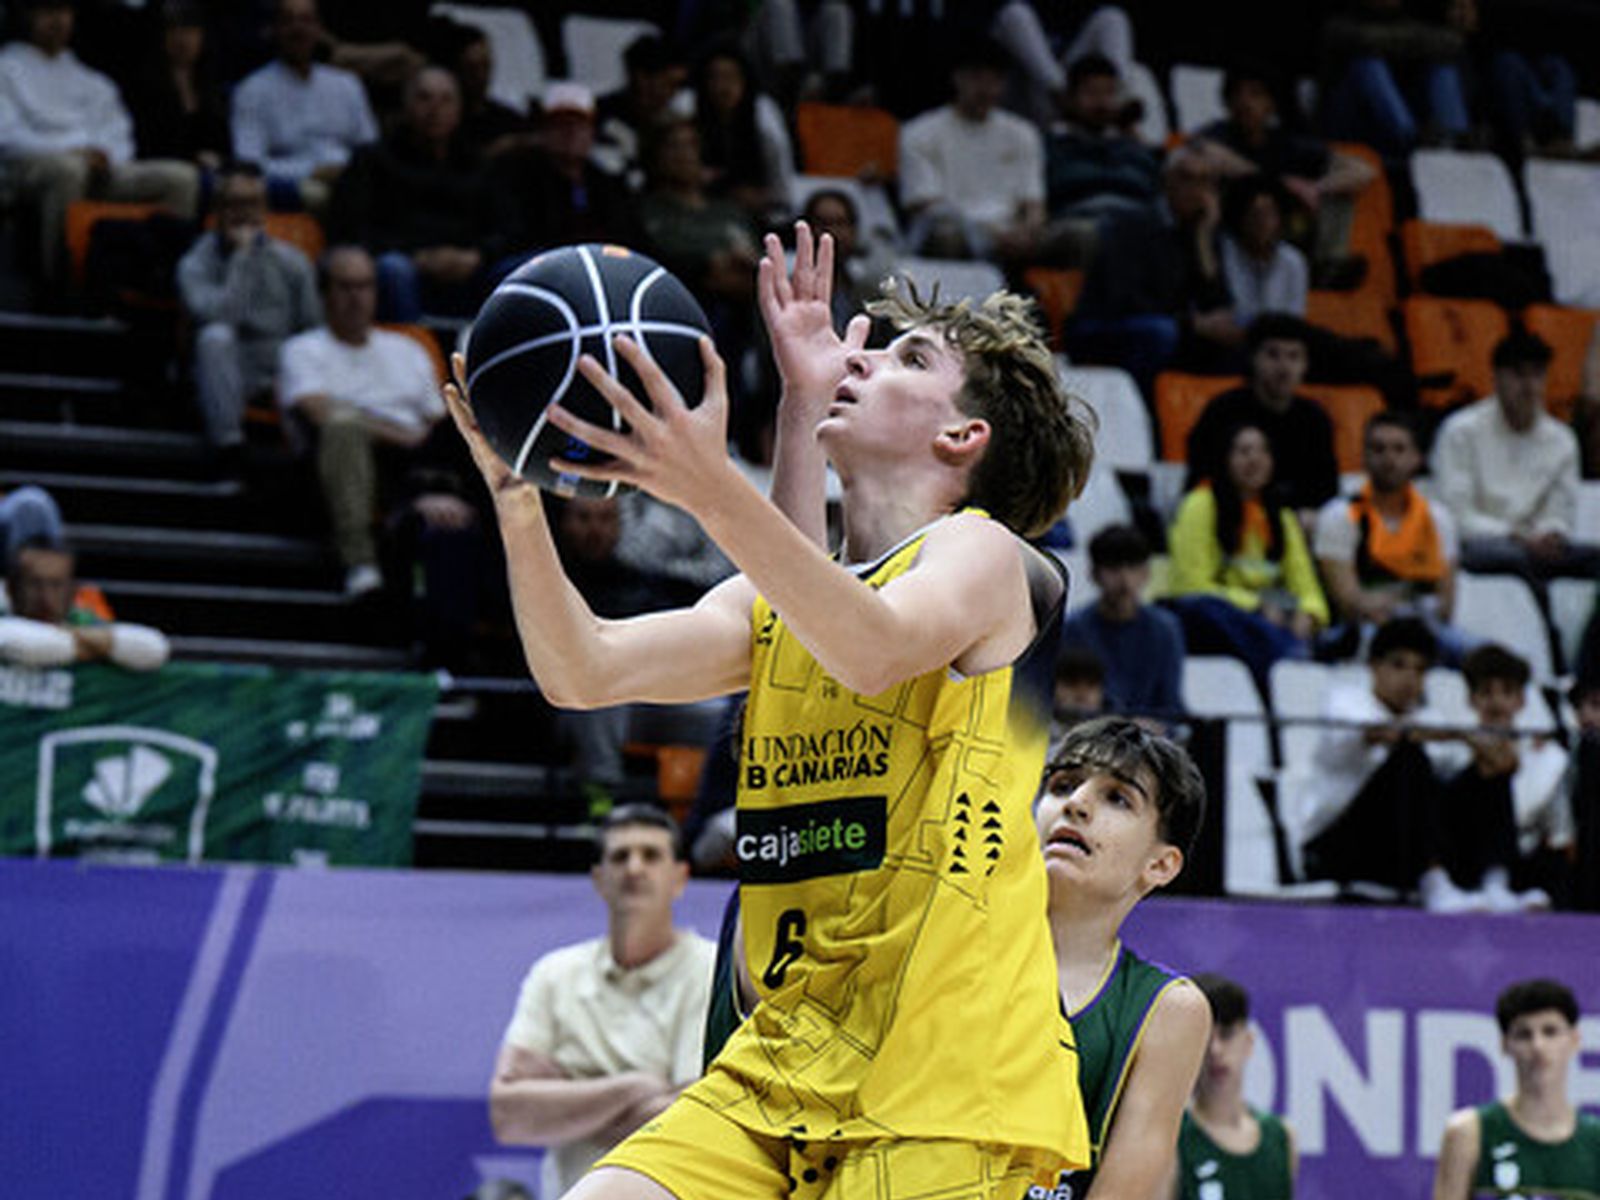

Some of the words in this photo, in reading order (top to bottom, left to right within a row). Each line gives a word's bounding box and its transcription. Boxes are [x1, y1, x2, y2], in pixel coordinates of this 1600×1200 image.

[747, 719, 893, 763] UNDACIÓN
[773, 752, 889, 789] CANARIAS
[736, 817, 868, 867] cajasiete
[763, 907, 807, 991] 6
